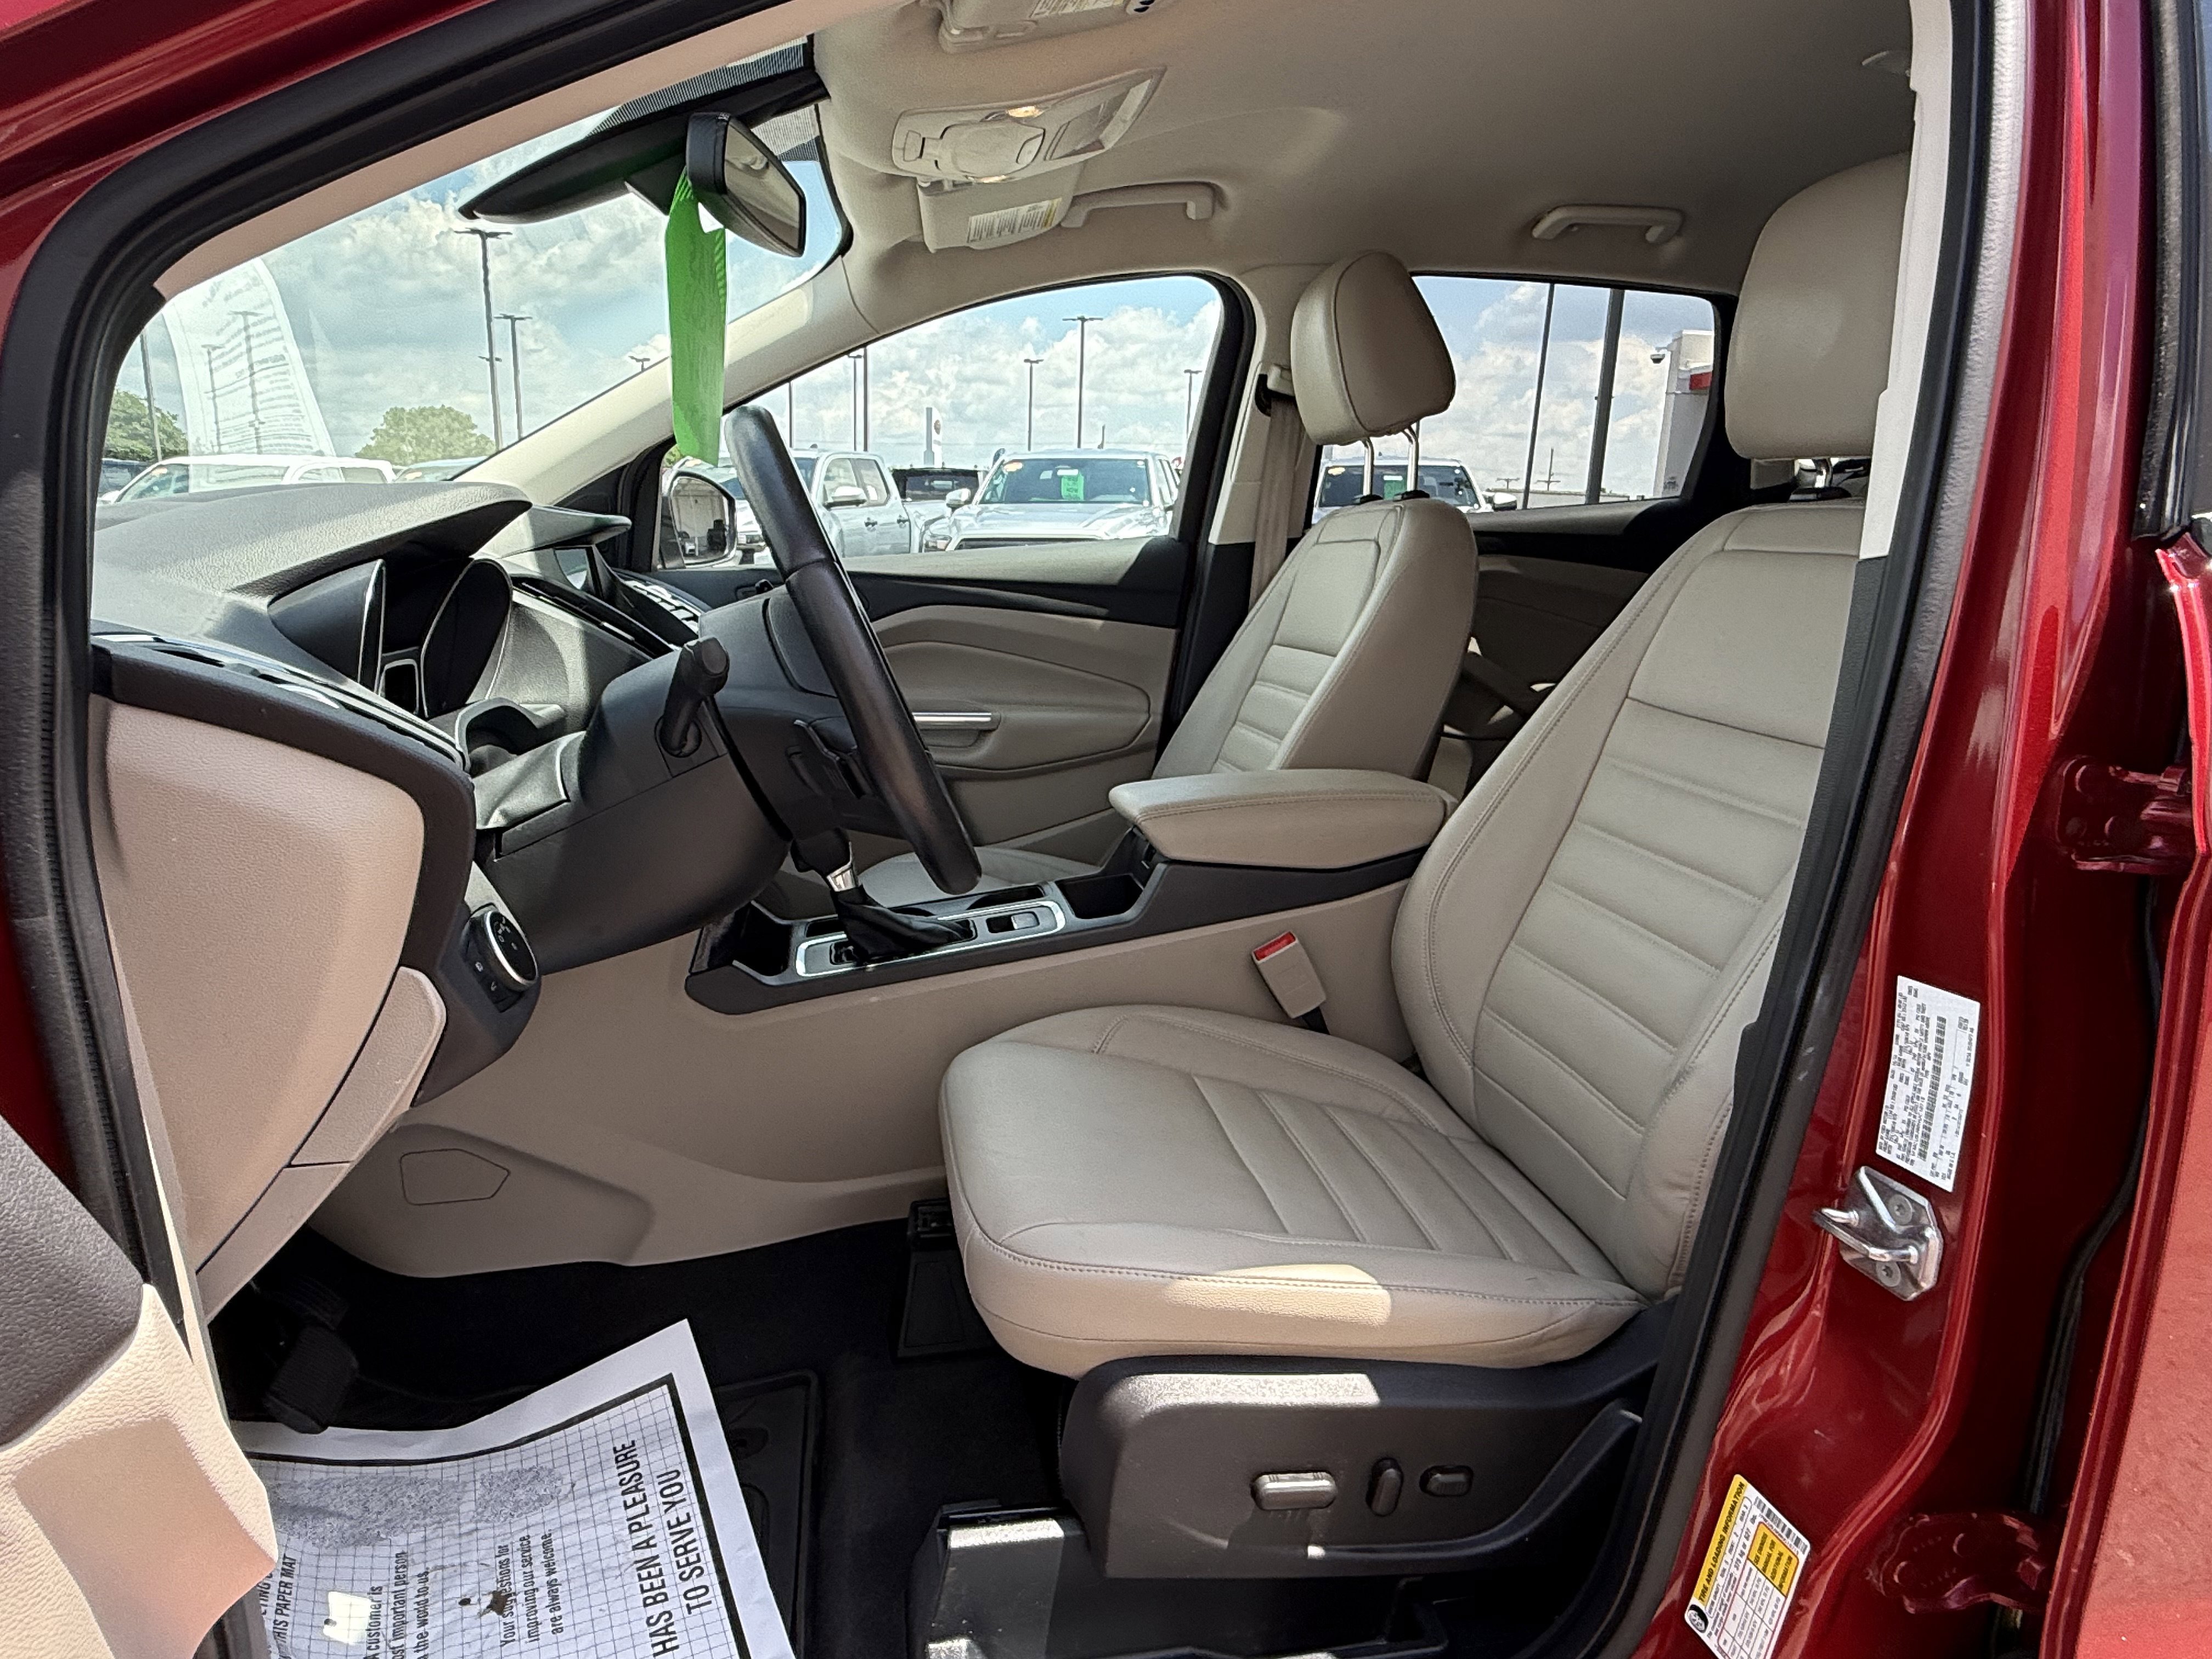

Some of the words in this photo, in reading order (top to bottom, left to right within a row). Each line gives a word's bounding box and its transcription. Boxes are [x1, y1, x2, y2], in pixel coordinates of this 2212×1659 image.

[613, 1440, 653, 1534] PLEASURE
[656, 1469, 687, 1514] YOU
[495, 1544, 509, 1558] for
[517, 1534, 532, 1568] service
[541, 1528, 557, 1576] welcome.
[632, 1534, 658, 1551] A
[667, 1512, 705, 1582] SERVE
[1698, 1584, 1708, 1602] TIRE
[1706, 1571, 1714, 1585] AND
[1714, 1534, 1726, 1567] LOADING
[1722, 1481, 1745, 1535] INFORMATION
[280, 1554, 296, 1579] MAT
[394, 1551, 409, 1587] person
[521, 1569, 535, 1587] our
[634, 1554, 669, 1607] BEEN
[275, 1579, 293, 1618] PAPER
[367, 1585, 383, 1595] is
[414, 1585, 429, 1599] to
[546, 1578, 562, 1613] always
[682, 1584, 713, 1615] TO
[366, 1598, 382, 1651] customer
[390, 1588, 409, 1642] important
[414, 1598, 429, 1629] world
[500, 1615, 516, 1645] Your
[520, 1587, 540, 1644] improving
[551, 1613, 564, 1635] are
[414, 1632, 429, 1654] the
[646, 1611, 680, 1657] HAS
[390, 1644, 405, 1659] ost
